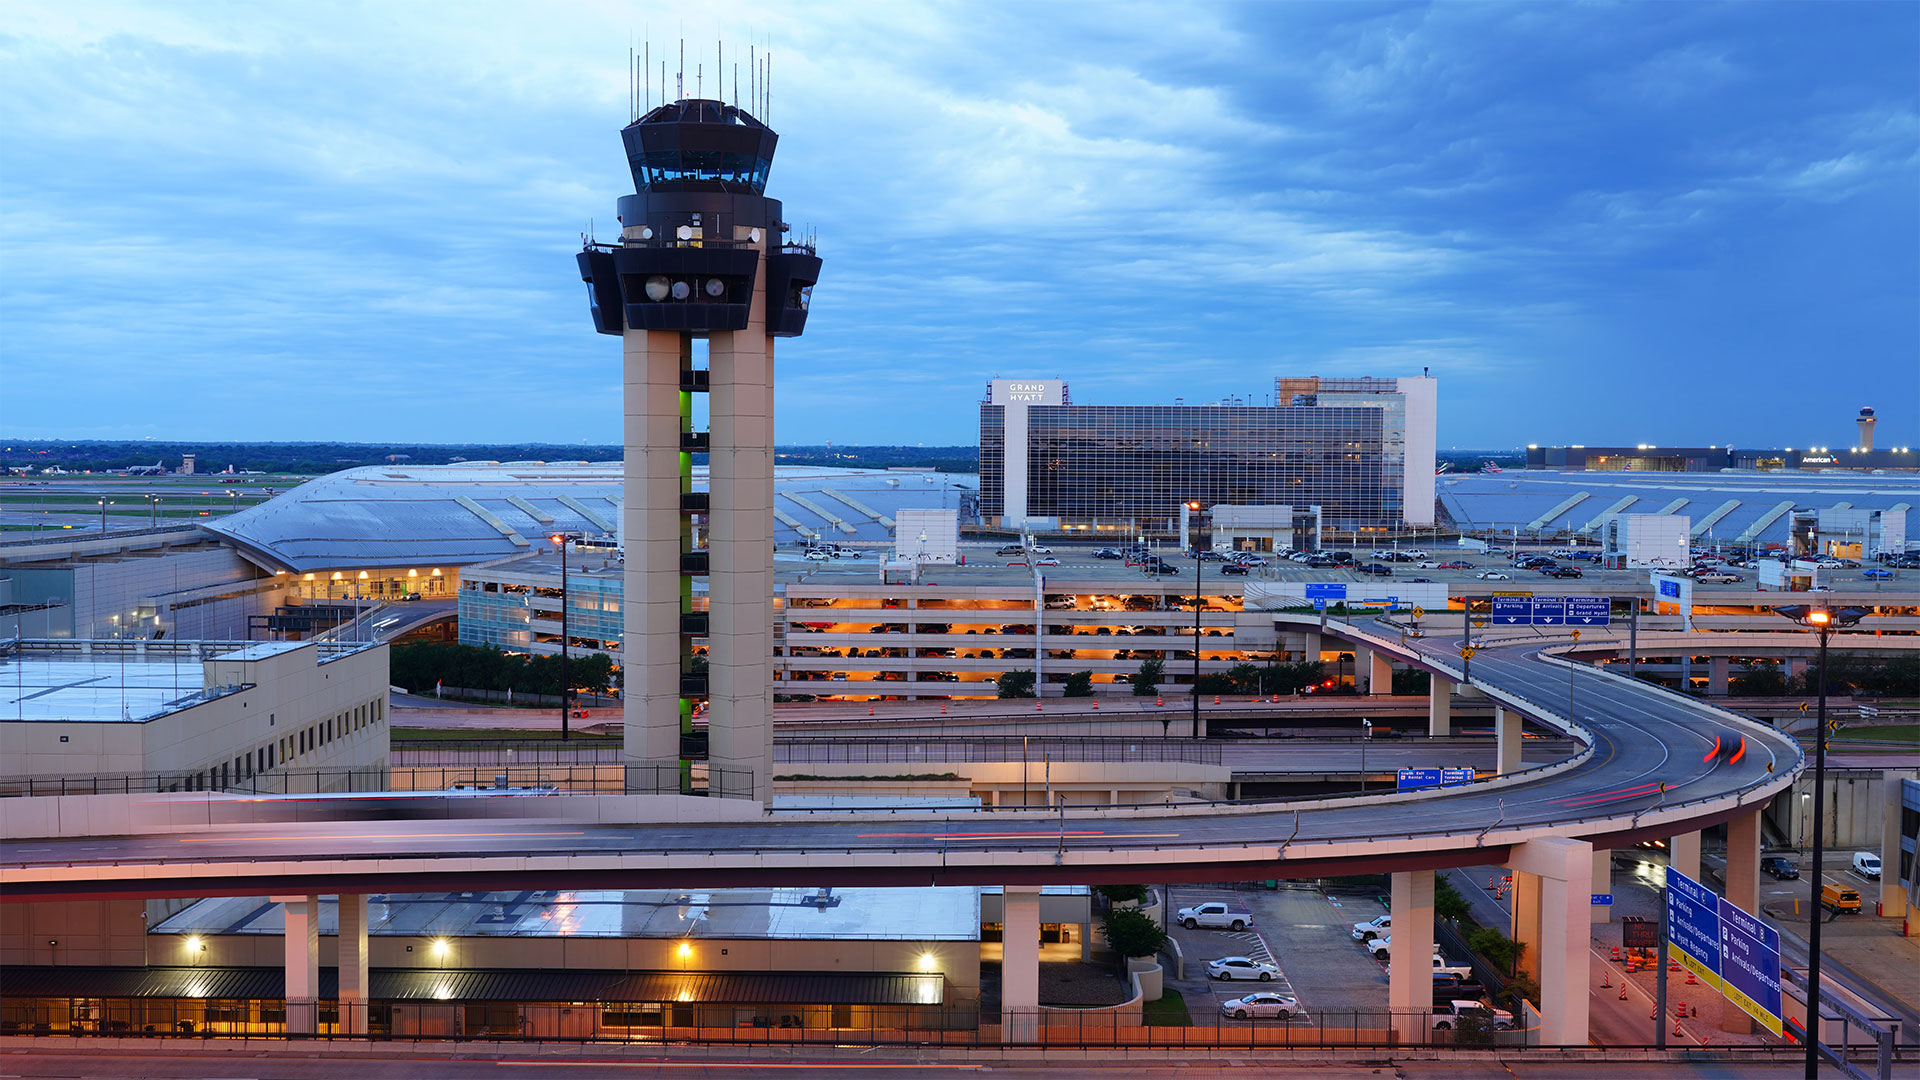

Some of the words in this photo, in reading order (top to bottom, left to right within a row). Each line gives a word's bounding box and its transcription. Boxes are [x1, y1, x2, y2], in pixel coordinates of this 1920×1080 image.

[1677, 877, 1698, 899] Terminal
[1701, 891, 1707, 903] C
[1675, 898, 1693, 918] Parking
[1677, 916, 1719, 950] Arrivals/Departures
[1731, 910, 1756, 935] Terminal
[1677, 932, 1689, 947] Hyatt
[1689, 940, 1709, 962] Regency
[1730, 933, 1750, 955] Parking
[1732, 952, 1780, 993] Arrivals/Departures
[1734, 992, 1743, 1003] LEFT
[1743, 999, 1752, 1009] EXIT
[1759, 1010, 1769, 1023] MILE
